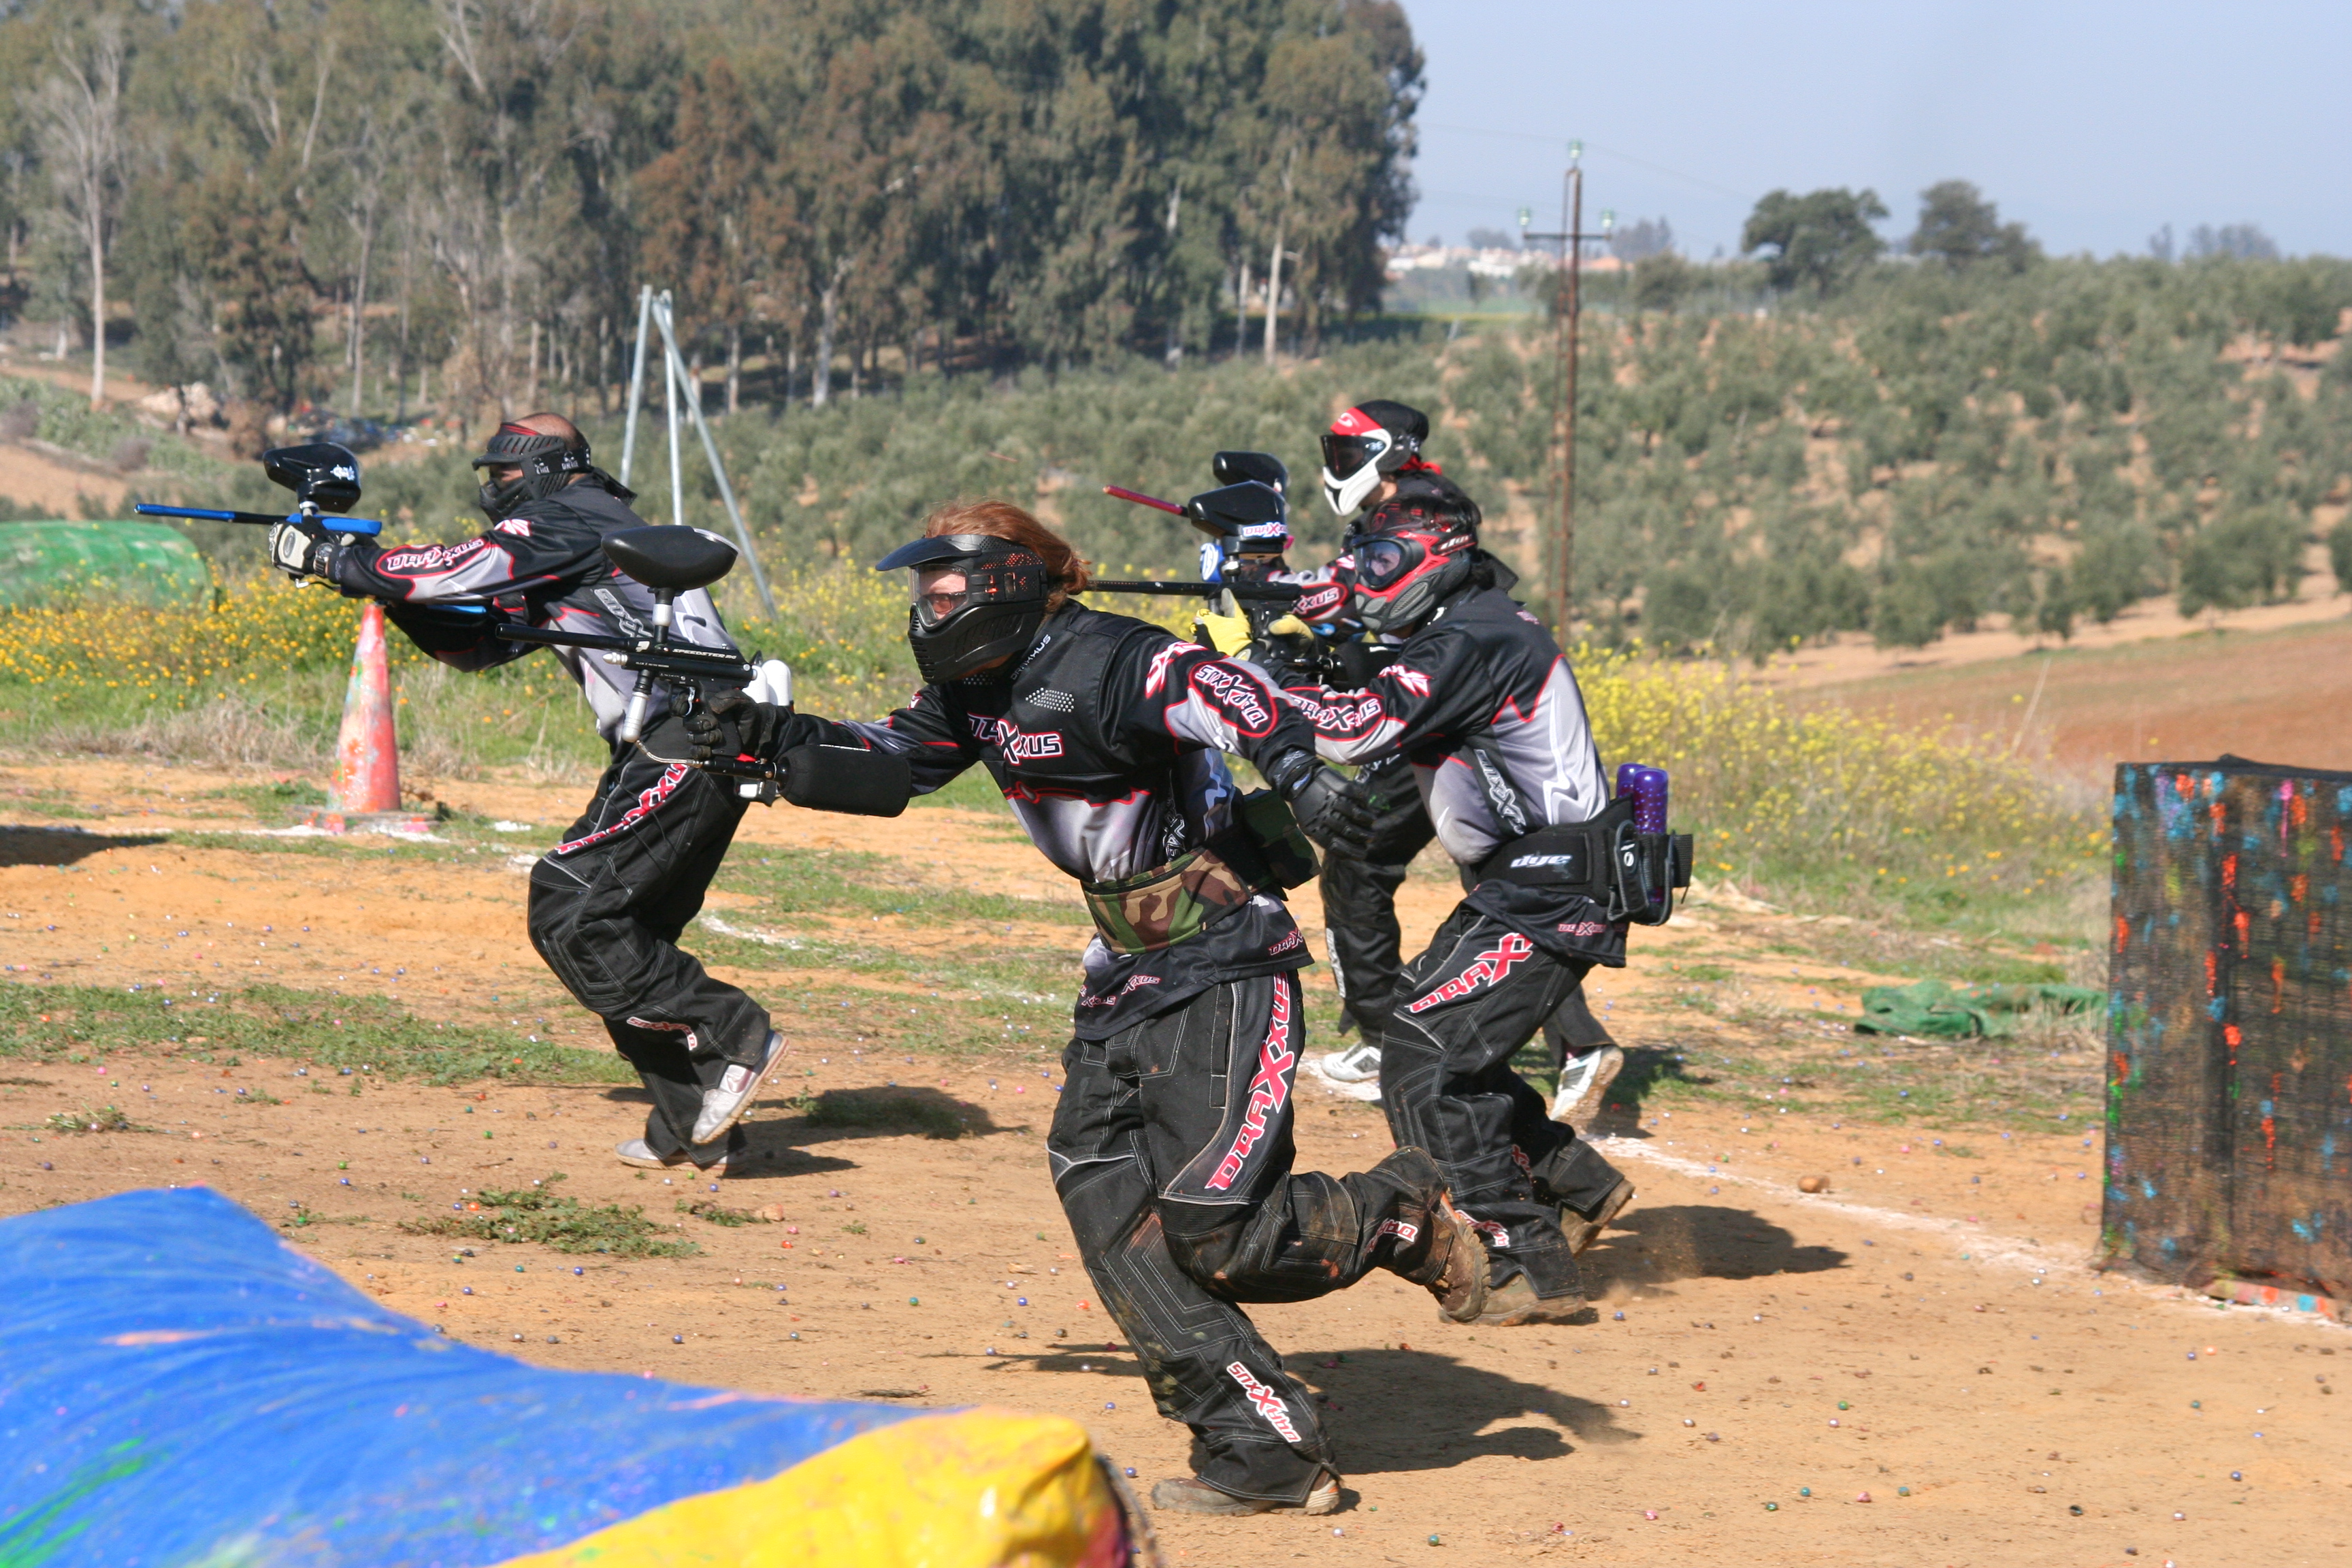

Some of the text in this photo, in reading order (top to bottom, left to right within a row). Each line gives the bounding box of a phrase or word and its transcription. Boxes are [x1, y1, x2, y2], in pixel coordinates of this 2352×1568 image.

[1243, 521, 1288, 538] DRAX
[1286, 587, 1340, 615] XXUS
[1510, 853, 1572, 869] dye
[1267, 926, 1304, 956] DRAX
[1404, 932, 1534, 1014] DRAX
[1226, 1360, 1303, 1443] DRAXXUS
